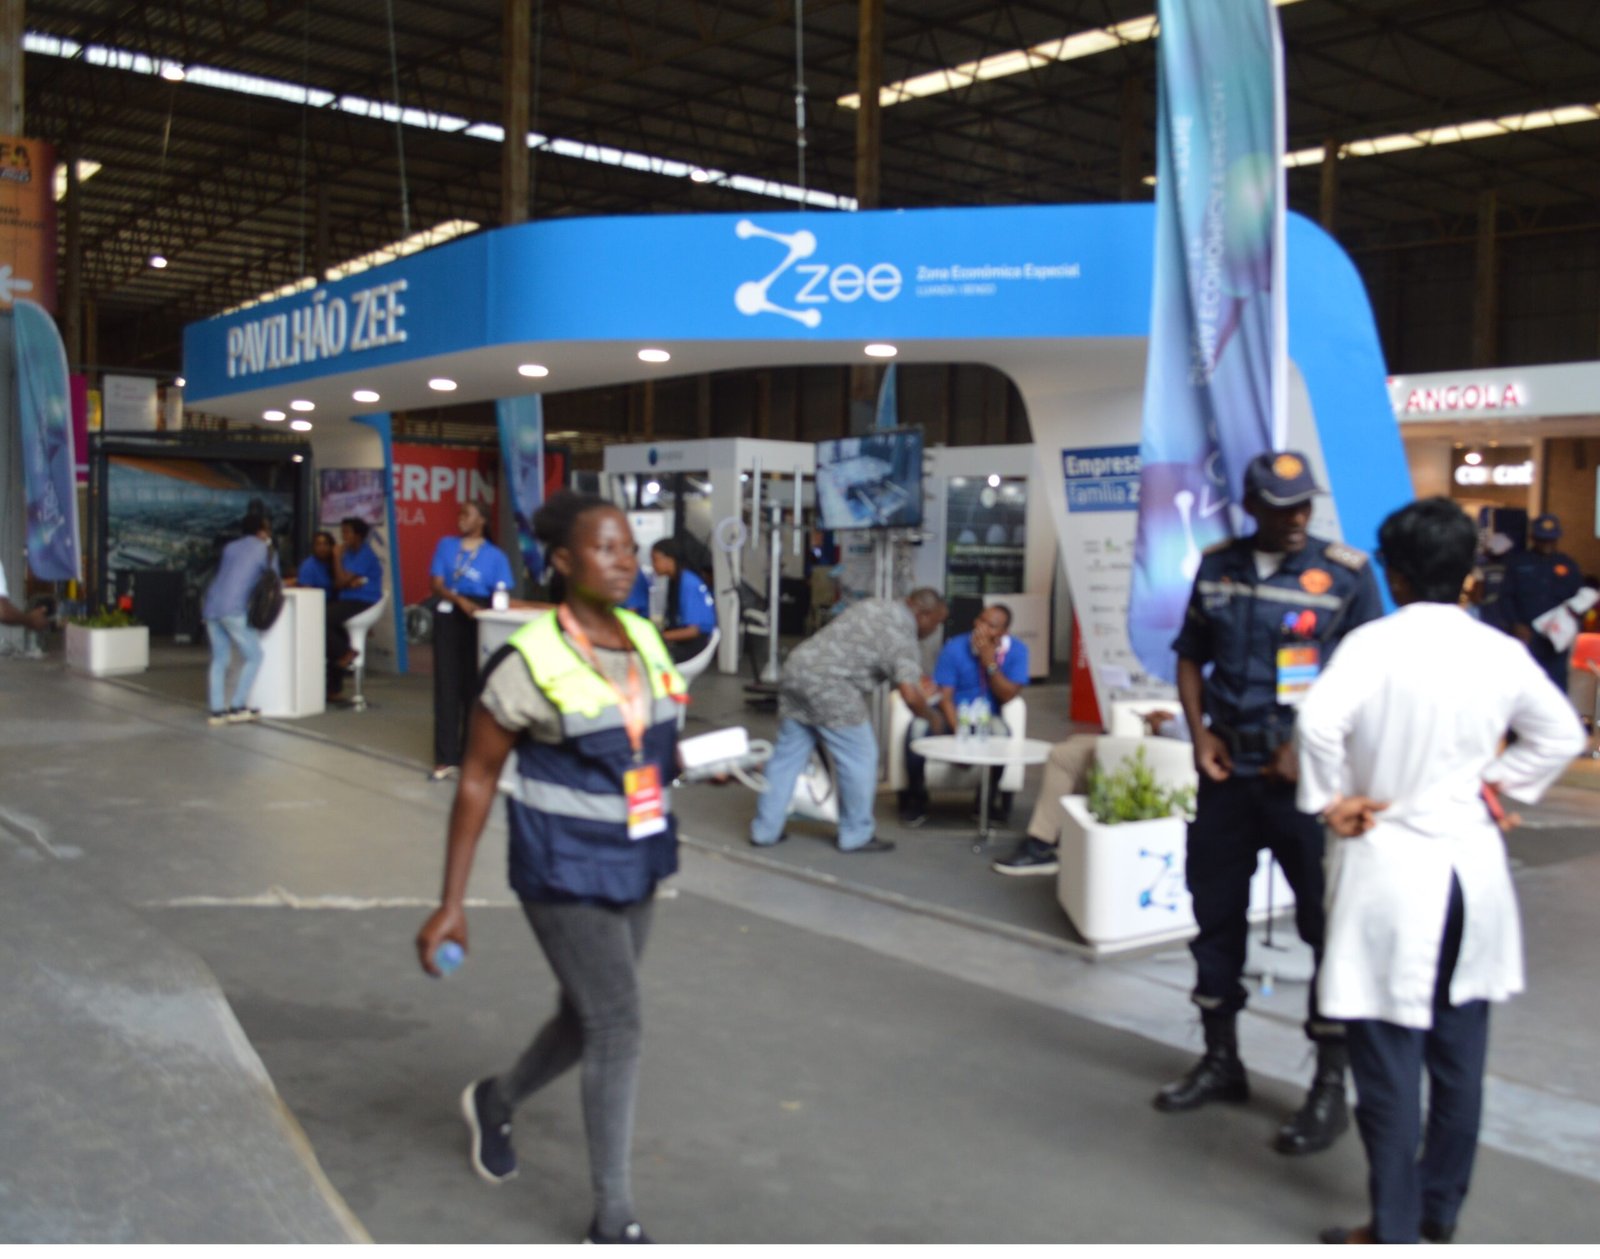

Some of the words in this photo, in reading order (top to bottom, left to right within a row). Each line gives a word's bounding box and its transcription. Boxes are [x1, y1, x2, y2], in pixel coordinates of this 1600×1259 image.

[795, 263, 902, 304] zee
[917, 265, 949, 281] Zona
[227, 289, 347, 378] PAVILHÃO
[351, 278, 409, 350] ZEE
[1405, 383, 1519, 416] ANGOLA
